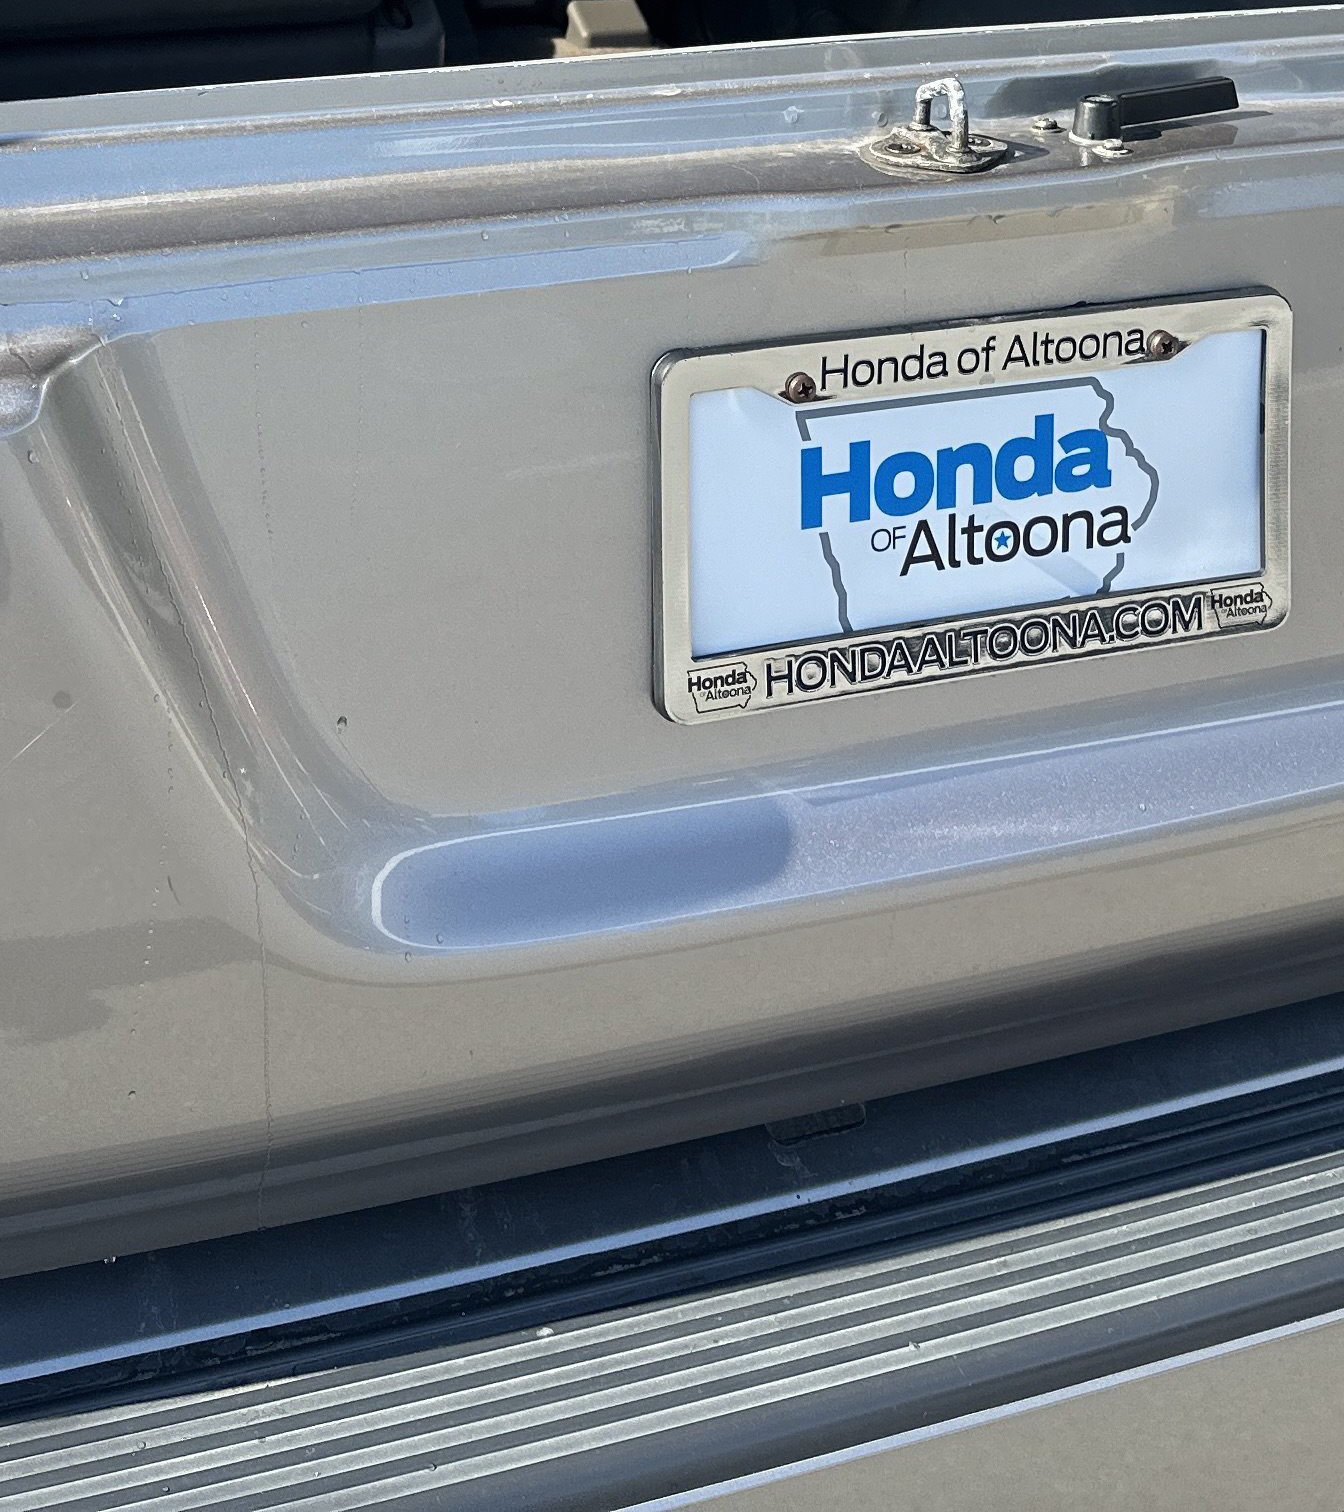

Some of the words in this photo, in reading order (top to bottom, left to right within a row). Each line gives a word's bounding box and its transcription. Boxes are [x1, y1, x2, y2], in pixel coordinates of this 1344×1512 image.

[820, 346, 948, 391] Honda
[955, 335, 998, 375] of
[1000, 324, 1146, 372] Altoona
[800, 414, 1111, 531] Honda
[870, 526, 907, 554] OF
[899, 503, 1132, 577] Altoona
[1211, 589, 1264, 609] Honda
[1226, 604, 1268, 618] Altoona
[765, 596, 1204, 699] HONDAALTOONA.COM
[688, 669, 747, 693] Honda
[705, 685, 752, 702] Altoona
